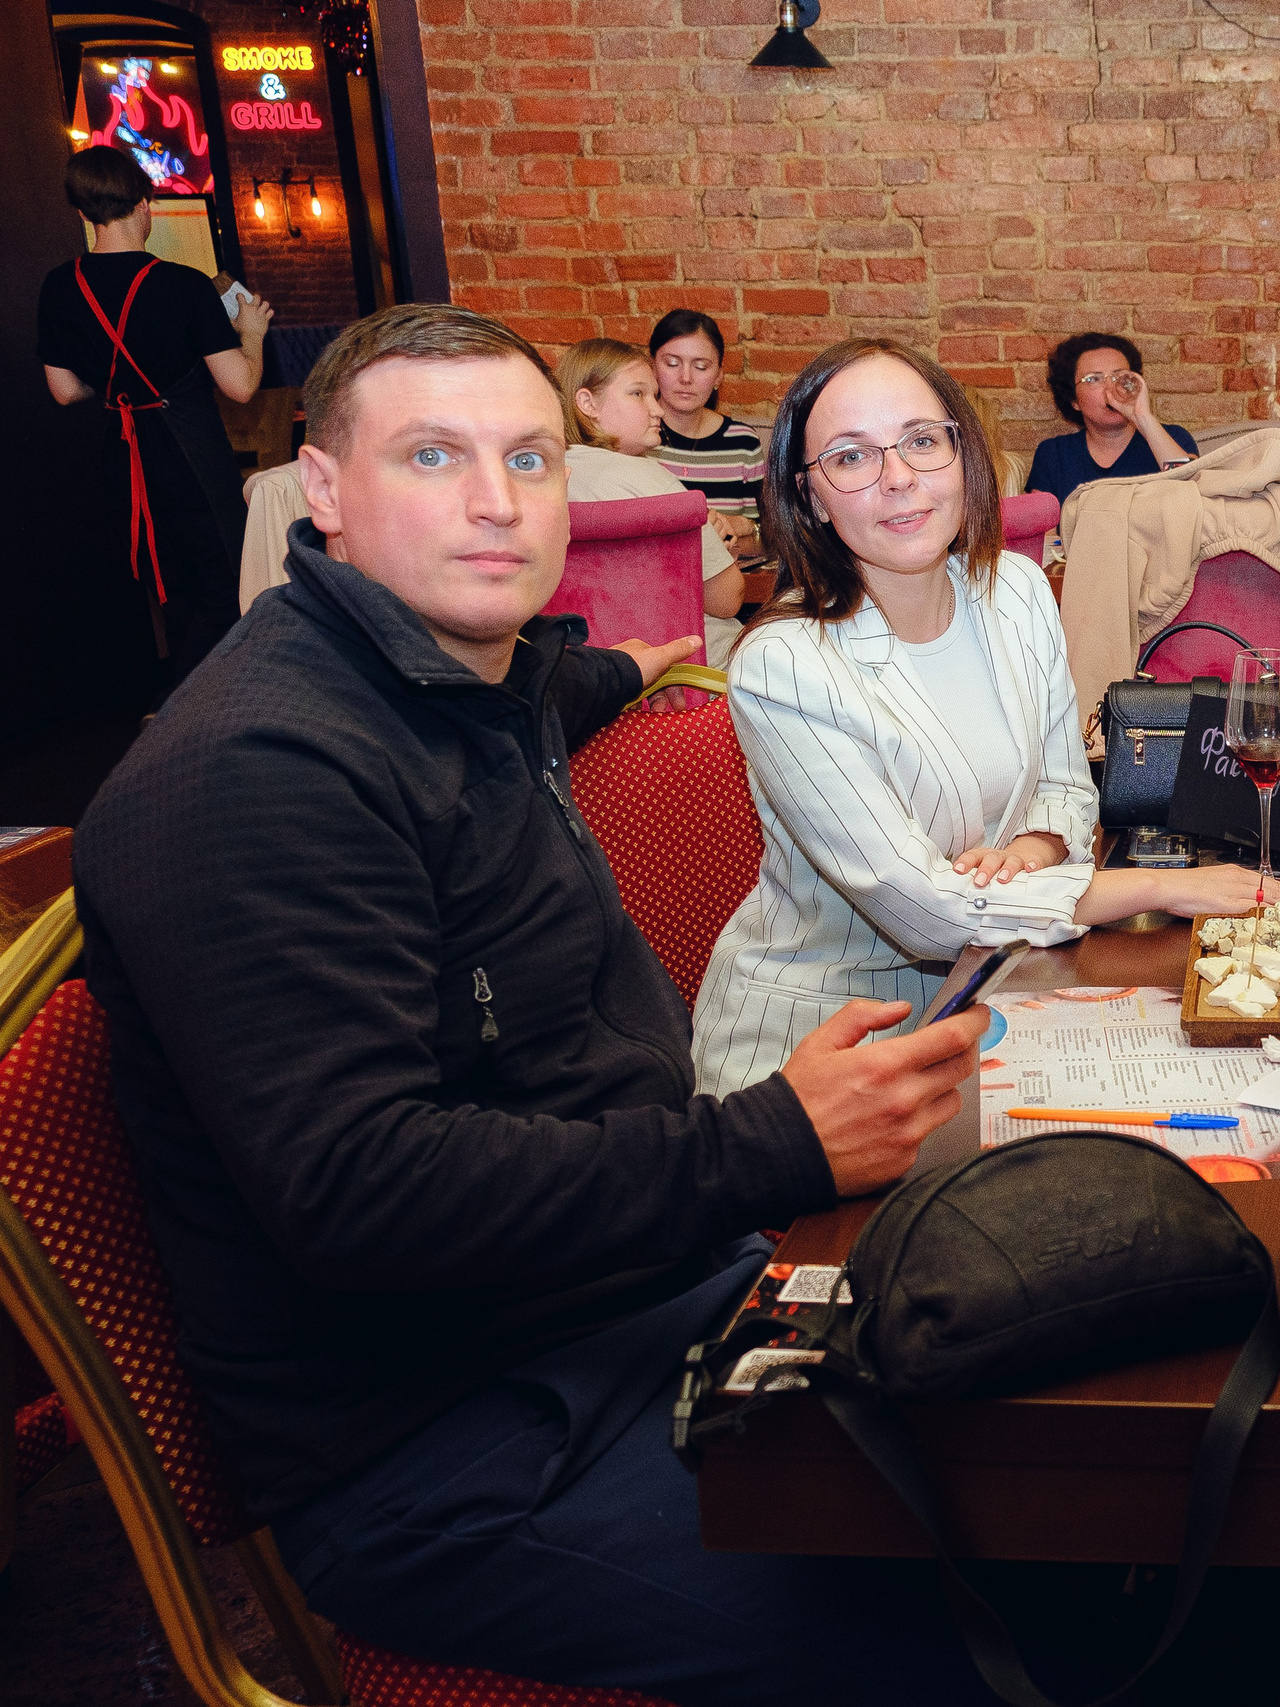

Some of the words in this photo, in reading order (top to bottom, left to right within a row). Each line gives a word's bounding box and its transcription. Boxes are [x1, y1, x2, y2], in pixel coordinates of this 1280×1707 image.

[222, 46, 314, 71] SMOKE
[260, 73, 286, 100] &
[230, 102, 322, 130] GRILL
